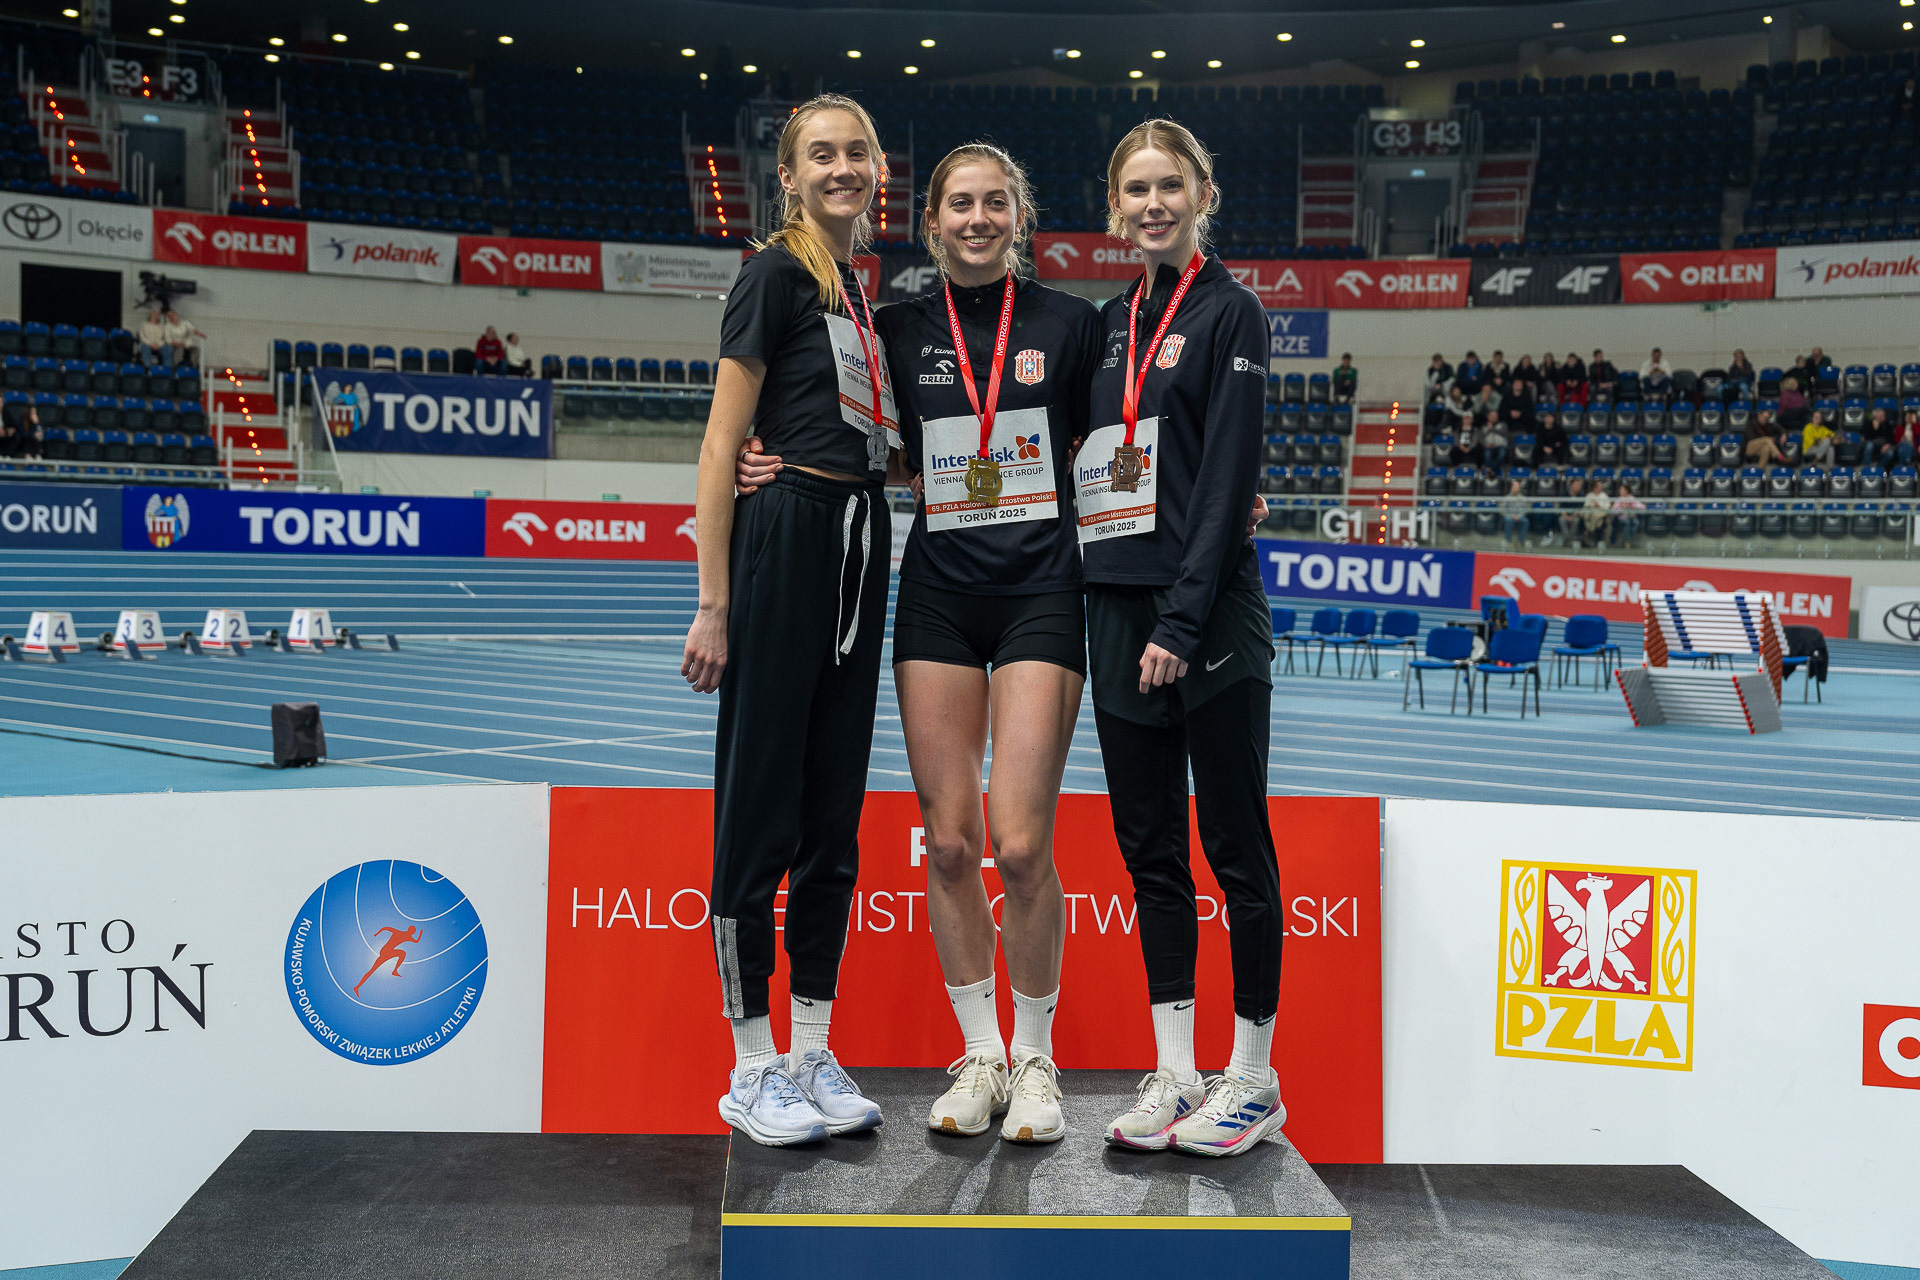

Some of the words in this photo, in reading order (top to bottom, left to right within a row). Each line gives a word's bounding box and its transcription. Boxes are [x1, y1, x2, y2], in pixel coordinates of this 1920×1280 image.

[106, 59, 142, 88] E3
[162, 65, 198, 95] F3
[1374, 123, 1412, 148] G3
[1425, 121, 1461, 146] H3
[77, 219, 143, 242] Okęcie
[212, 230, 296, 256] ORLEN
[352, 242, 440, 267] polanik
[513, 252, 592, 275] ORLEN
[649, 255, 711, 268] Ministerstwo
[1092, 247, 1144, 265] ORLE
[649, 268, 681, 280] Sportu
[688, 269, 731, 282] Turystyki
[890, 265, 937, 294] 4F
[1230, 267, 1303, 292] ZLA
[1481, 267, 1533, 295] 4F
[1556, 265, 1609, 293] 4F
[1680, 263, 1765, 286] ORLEN
[1823, 254, 1920, 285] polanik
[1163, 267, 1196, 323] MISTRZOSTWA
[1380, 273, 1458, 294] ORLEN
[950, 309, 968, 366] MISTRZOSTWA
[996, 298, 1012, 356] MISTRZOSTWA
[1148, 323, 1167, 353] POLSKI
[1271, 335, 1311, 354] RZE
[1140, 353, 1153, 374] 2025
[920, 375, 953, 384] ORLEN
[373, 387, 541, 437] TORUŃ
[931, 446, 1016, 470] Interisk
[933, 475, 965, 486] VIENNA
[1015, 467, 1044, 477] GROUP
[1079, 460, 1114, 482] Inter
[931, 505, 942, 513] 69.
[942, 503, 959, 511] PZLA
[997, 496, 1031, 506] trzostwa
[1031, 493, 1053, 502] Polski
[1081, 486, 1099, 498] VIENNA
[0, 498, 98, 534] ORUŃ
[239, 502, 420, 547] TORUŃ
[957, 508, 997, 524] TORUŃ
[999, 508, 1027, 519] 2025
[1110, 508, 1140, 519] Mistrzostwa
[1322, 508, 1362, 540] G1
[1391, 509, 1430, 541] H1
[554, 518, 646, 543] ORLEN
[1094, 521, 1116, 536] TORUŃ
[1116, 520, 1137, 532] 2025
[1269, 553, 1443, 599] TORUŃ
[1543, 575, 1641, 605] ORLEN
[1733, 588, 1833, 619] LEN
[54, 620, 67, 642] 4
[142, 618, 155, 640] 3
[209, 618, 220, 638] 2
[229, 618, 242, 638] 2
[297, 617, 304, 636] 1
[315, 616, 324, 636] 1
[571, 886, 789, 933] HALOE
[1195, 894, 1360, 938] PSKI
[0, 918, 136, 959] STO
[290, 917, 341, 1045] KUJAWSKO-POMORSKI
[337, 1036, 393, 1061] ZWIĄZEK
[393, 1030, 442, 1060] LEKKIEJ
[439, 986, 478, 1038] ATLETYKI
[1506, 992, 1682, 1060] PZLA
